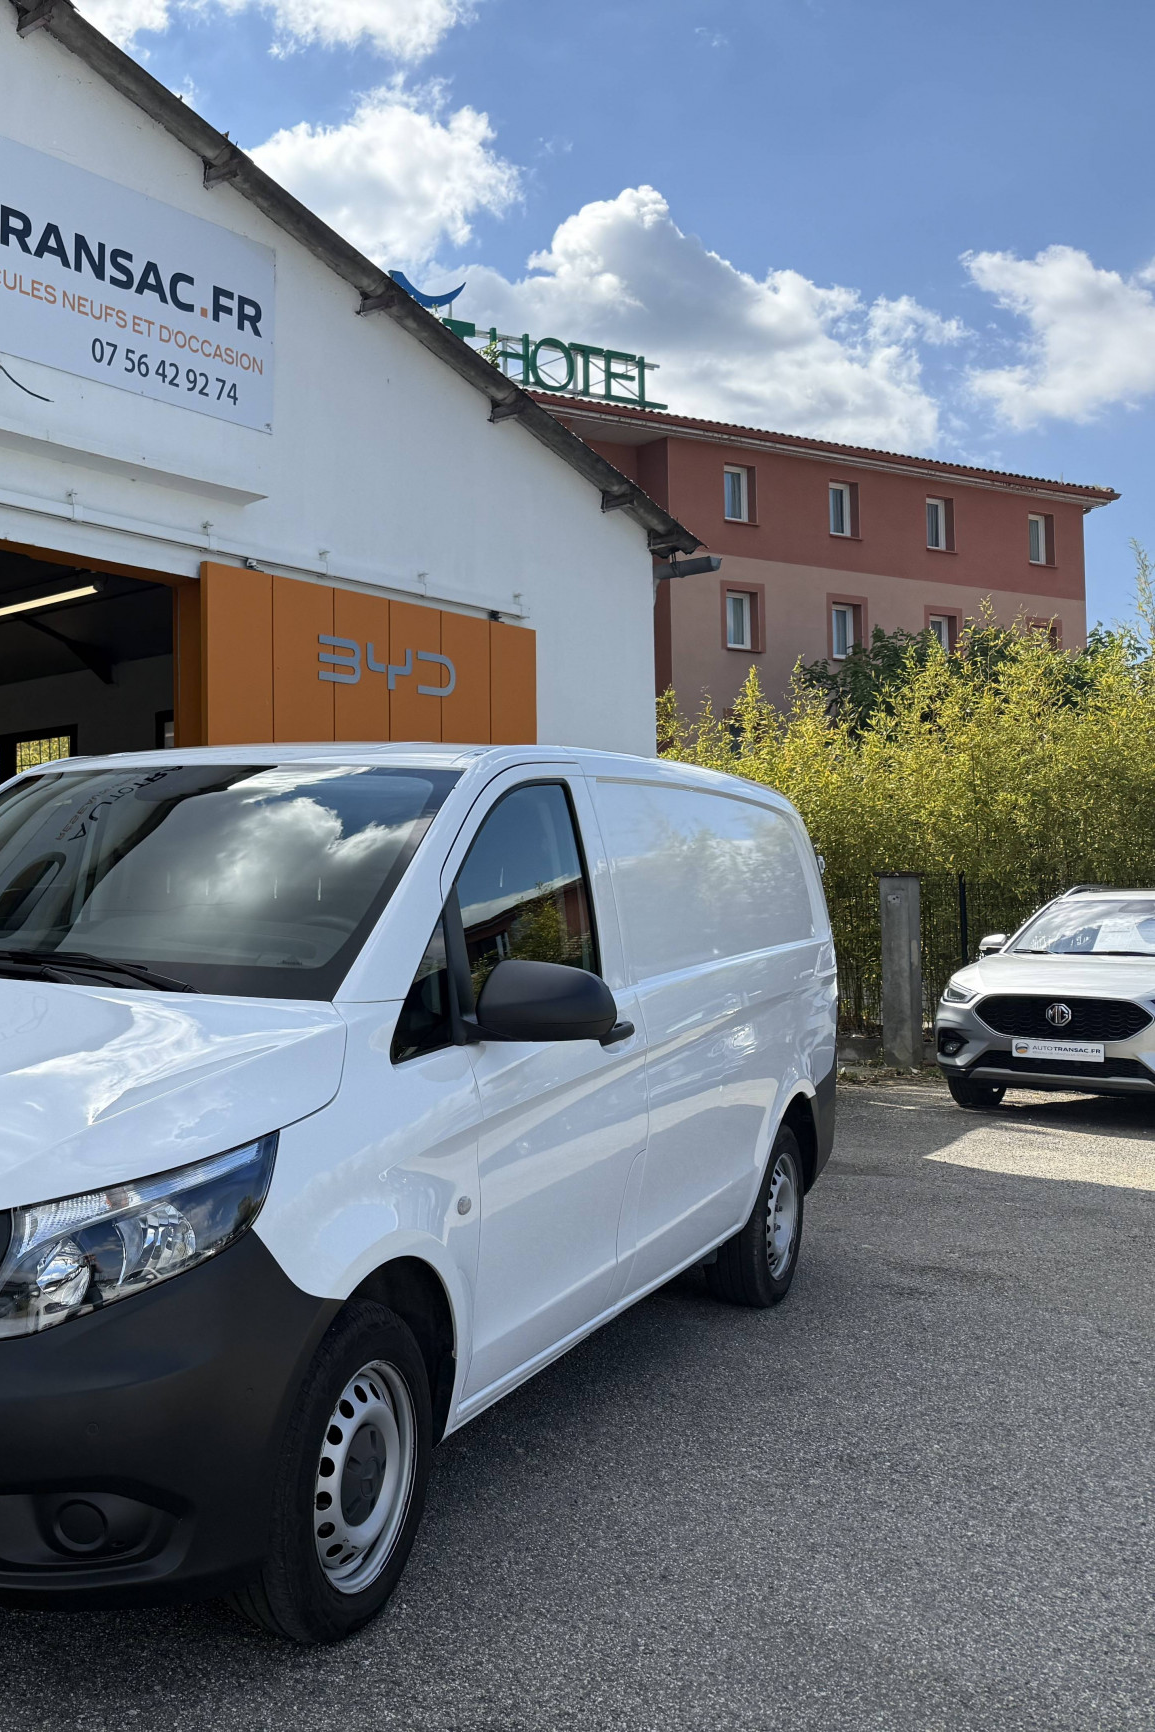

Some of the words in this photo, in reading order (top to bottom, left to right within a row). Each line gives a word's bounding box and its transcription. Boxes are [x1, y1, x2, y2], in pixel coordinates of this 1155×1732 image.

[62, 290, 127, 329] NEUFS
[132, 315, 155, 337] ET
[159, 324, 263, 375] D'OCCASION
[91, 338, 118, 366] 07
[124, 348, 149, 377] 56
[155, 359, 180, 388] 42
[185, 368, 210, 397] 92
[215, 377, 239, 406] 74
[318, 634, 456, 697] BYD
[1048, 1005, 1069, 1024] MG
